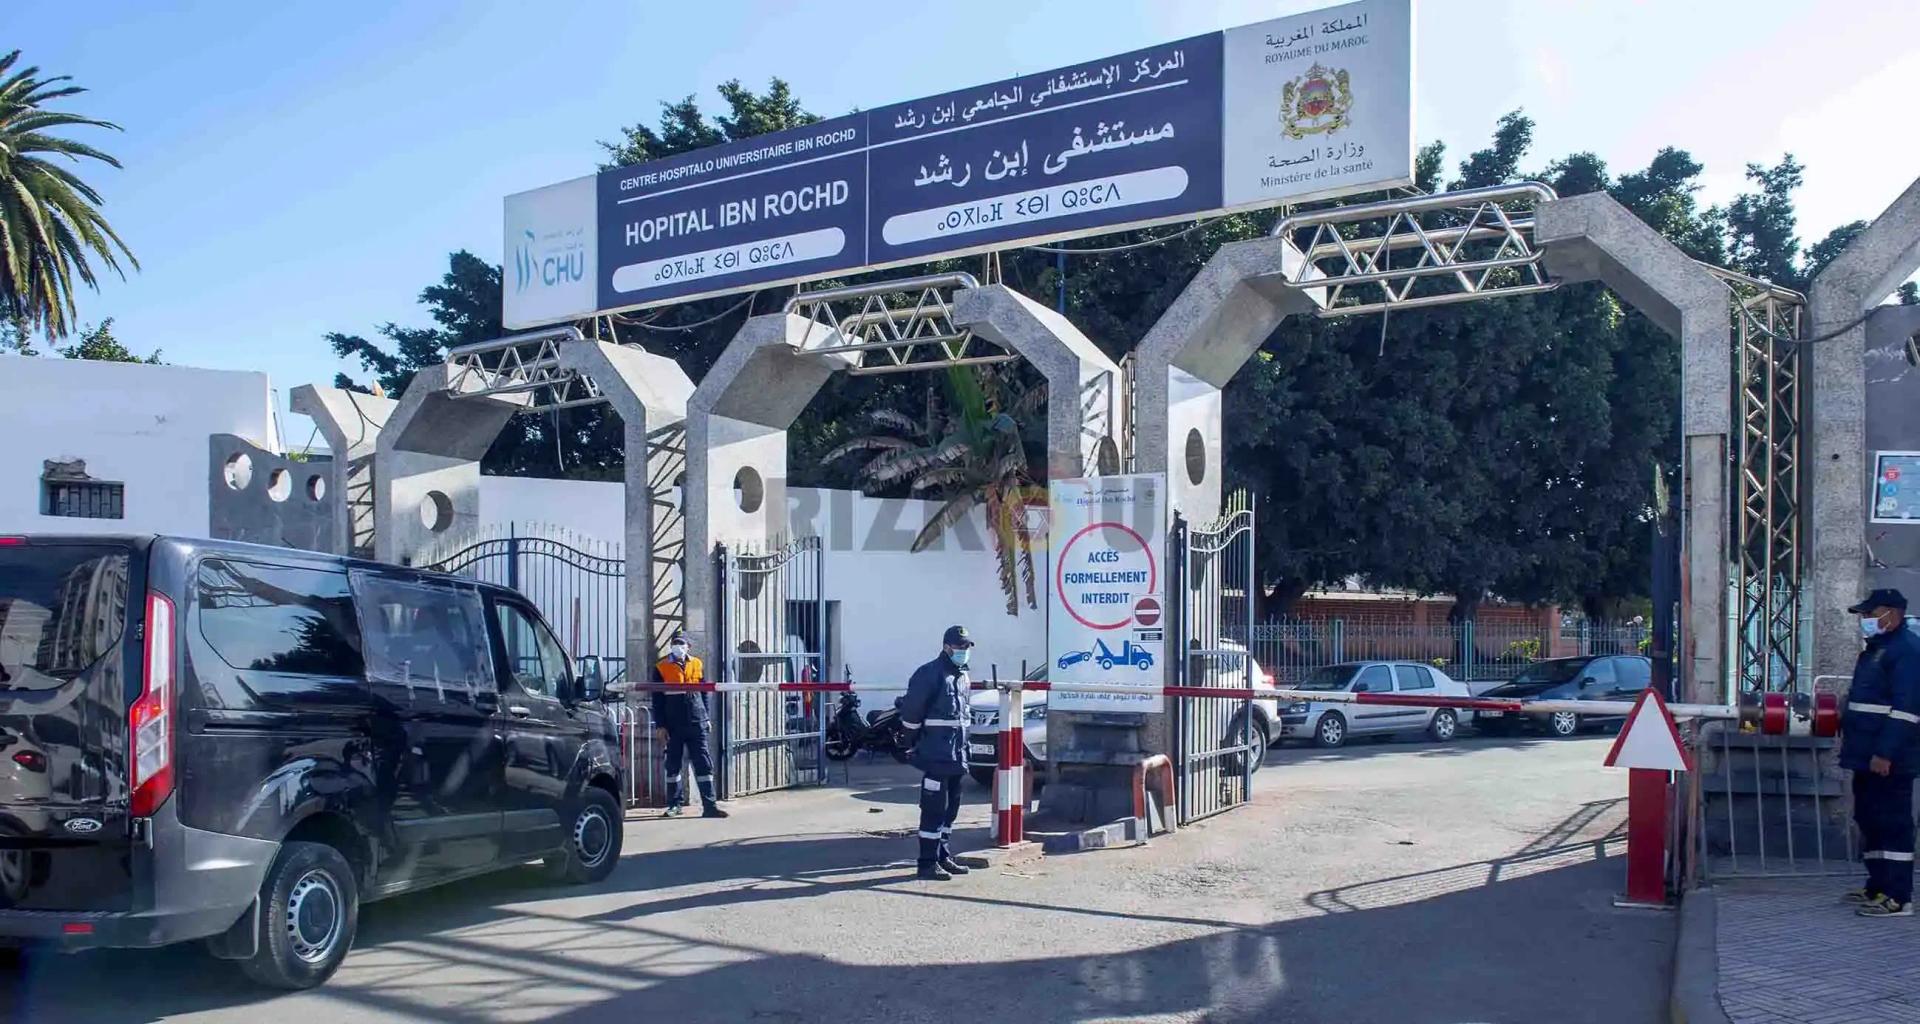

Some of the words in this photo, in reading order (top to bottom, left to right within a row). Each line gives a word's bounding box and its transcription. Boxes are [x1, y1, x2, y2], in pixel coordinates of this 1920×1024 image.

[1265, 24, 1314, 49] المغربية
[1321, 13, 1368, 35] المملكة
[1265, 46, 1312, 64] ROYAUME
[1314, 43, 1329, 55] DU
[1331, 35, 1370, 51] MAROC
[1129, 50, 1185, 83] المركز
[931, 101, 955, 124] إبن
[962, 86, 1023, 121] الجامعي
[894, 108, 925, 128] رشد
[620, 173, 658, 191] CENTRE
[659, 160, 714, 183] HOSPITALO
[716, 142, 792, 170] UNIVERSITAIRE
[795, 137, 814, 153] IBN
[816, 128, 856, 148] ROCHD
[984, 139, 1029, 181] إبن
[1043, 121, 1175, 175] مستشفى
[1268, 148, 1320, 169] الصحة
[1327, 142, 1365, 160] وزارة
[914, 153, 972, 187] رشد
[1313, 167, 1328, 178] de
[1330, 165, 1341, 176] la
[1343, 159, 1374, 175] santé
[626, 207, 714, 247] HOPITAL
[719, 197, 757, 228] IBN
[764, 180, 849, 219] ROCHD
[543, 250, 584, 286] CHU
[1064, 570, 1148, 585] FORMELLEMENT
[1081, 592, 1130, 605] INTERDIT
